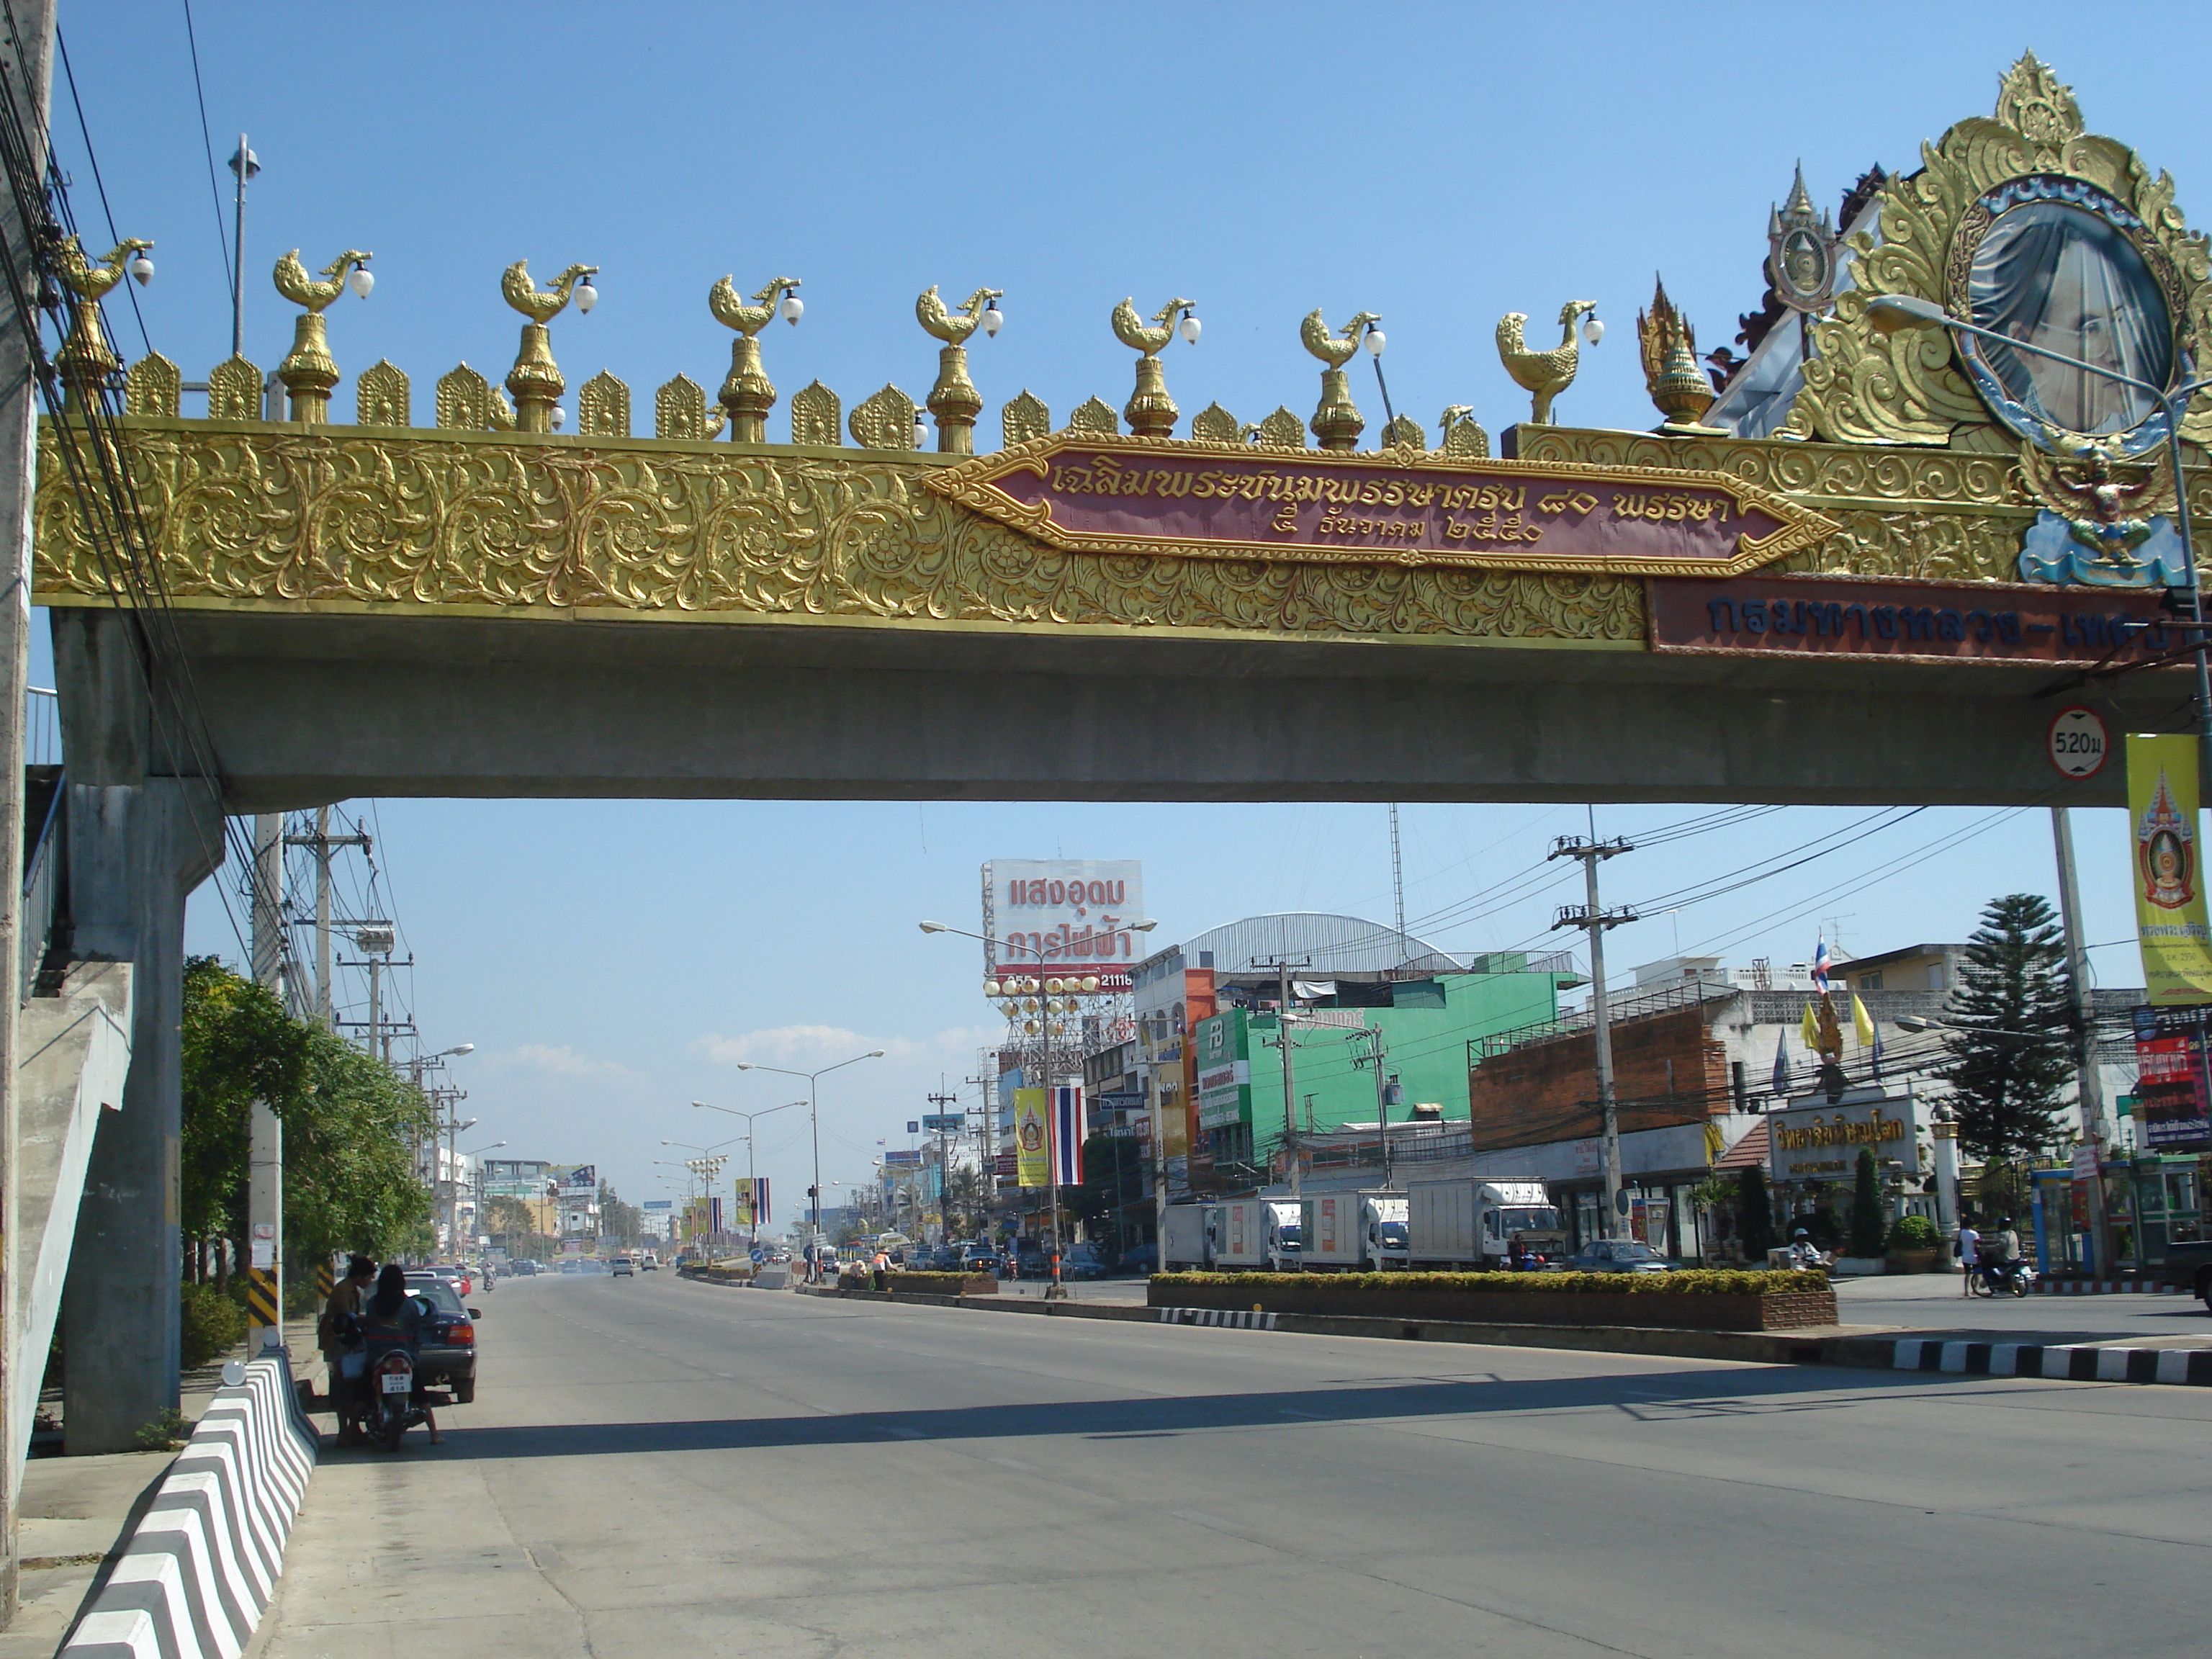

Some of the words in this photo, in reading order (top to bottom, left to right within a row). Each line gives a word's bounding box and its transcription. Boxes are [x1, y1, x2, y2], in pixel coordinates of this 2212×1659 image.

[1051, 455, 1527, 513] เฉลิมพระชนมพรรษาครบ
[1538, 488, 1599, 516] ๘๐
[1613, 492, 1730, 523] พรรษา
[1271, 503, 1299, 533] ๕
[1319, 507, 1426, 539] ธันวาคม
[1444, 513, 1545, 542] ๒๕๕๐
[1708, 595, 2021, 644] กรมทางหลวง
[1010, 878, 1125, 916] แสงอุดม
[1007, 915, 1132, 958] การไฟฟ้า
[1774, 1109, 1905, 1154] วิทยาลัยพิษณุโลก
